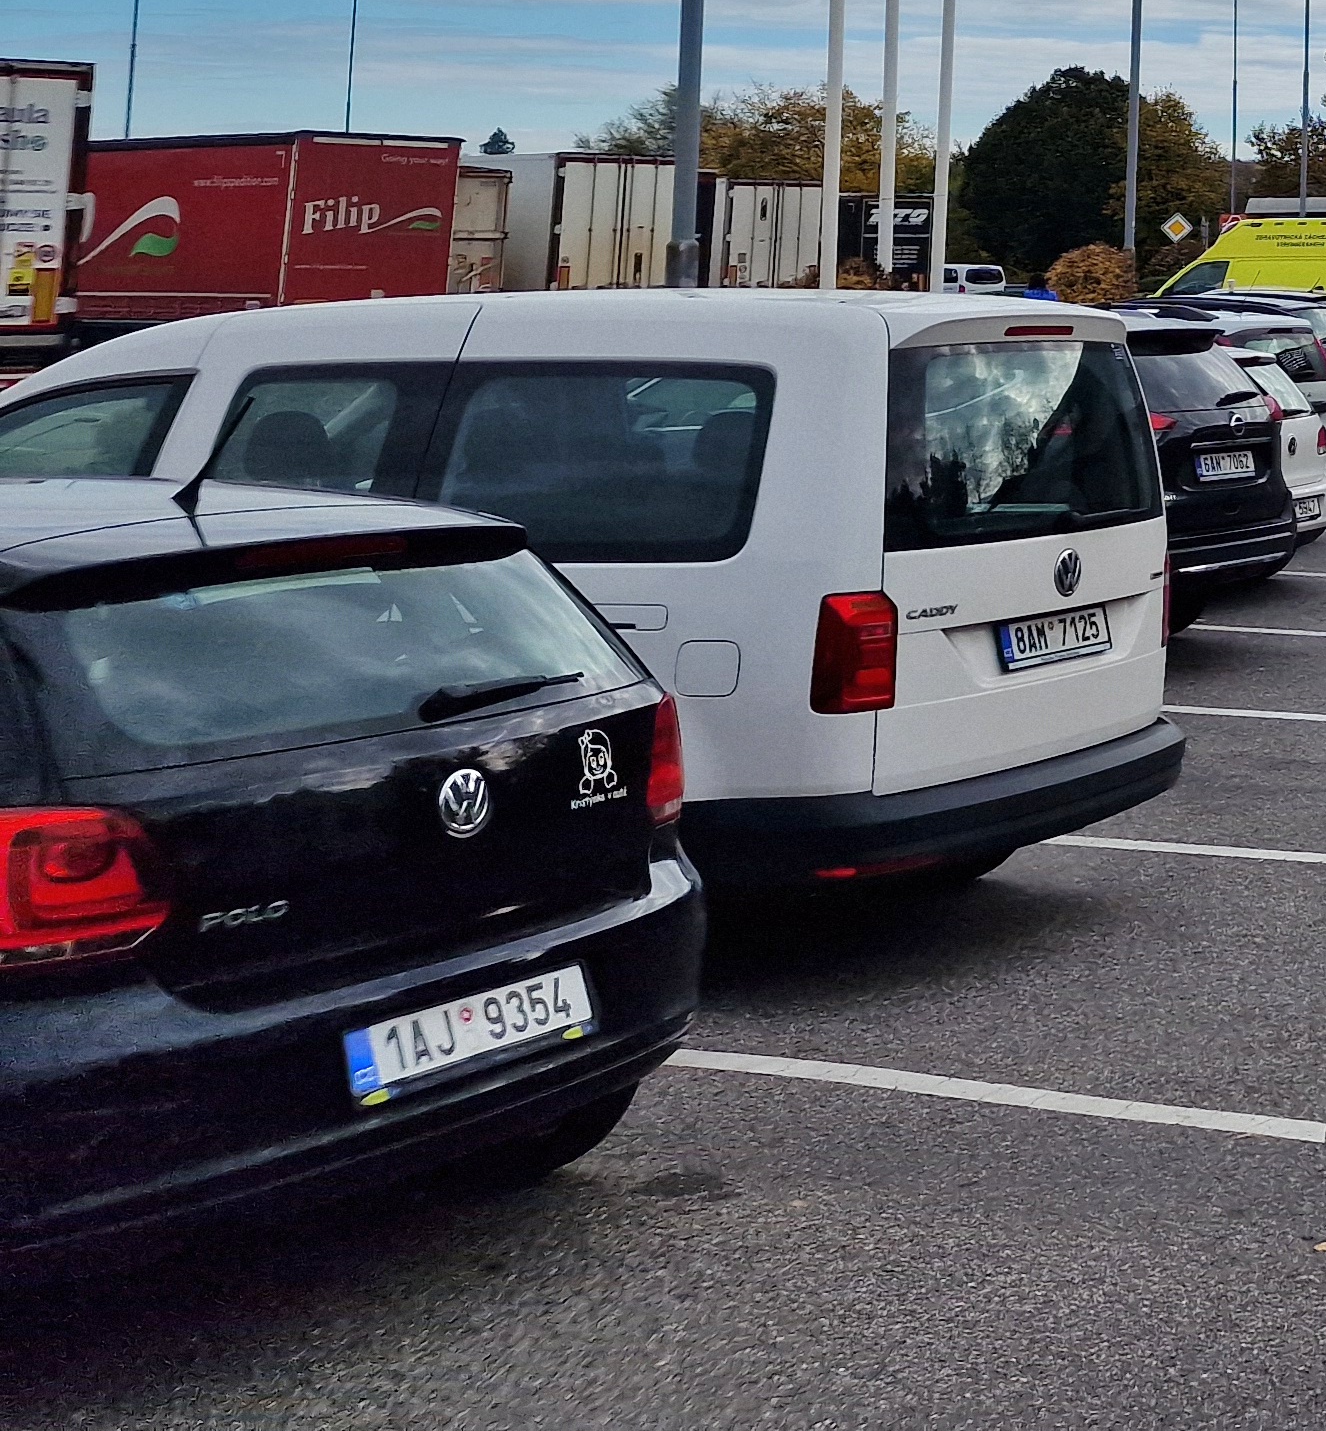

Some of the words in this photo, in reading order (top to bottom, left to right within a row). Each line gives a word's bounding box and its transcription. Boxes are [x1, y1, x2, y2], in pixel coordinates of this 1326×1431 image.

[301, 195, 381, 235] Filip
[1202, 456, 1222, 473] 6AN
[1228, 453, 1250, 470] 7062
[905, 604, 959, 620] CADDY
[1014, 621, 1049, 655] 8AM
[1058, 612, 1100, 647] 7125
[199, 899, 290, 933] POLO
[385, 1010, 456, 1072] 1AJ
[483, 976, 572, 1041] 9354
